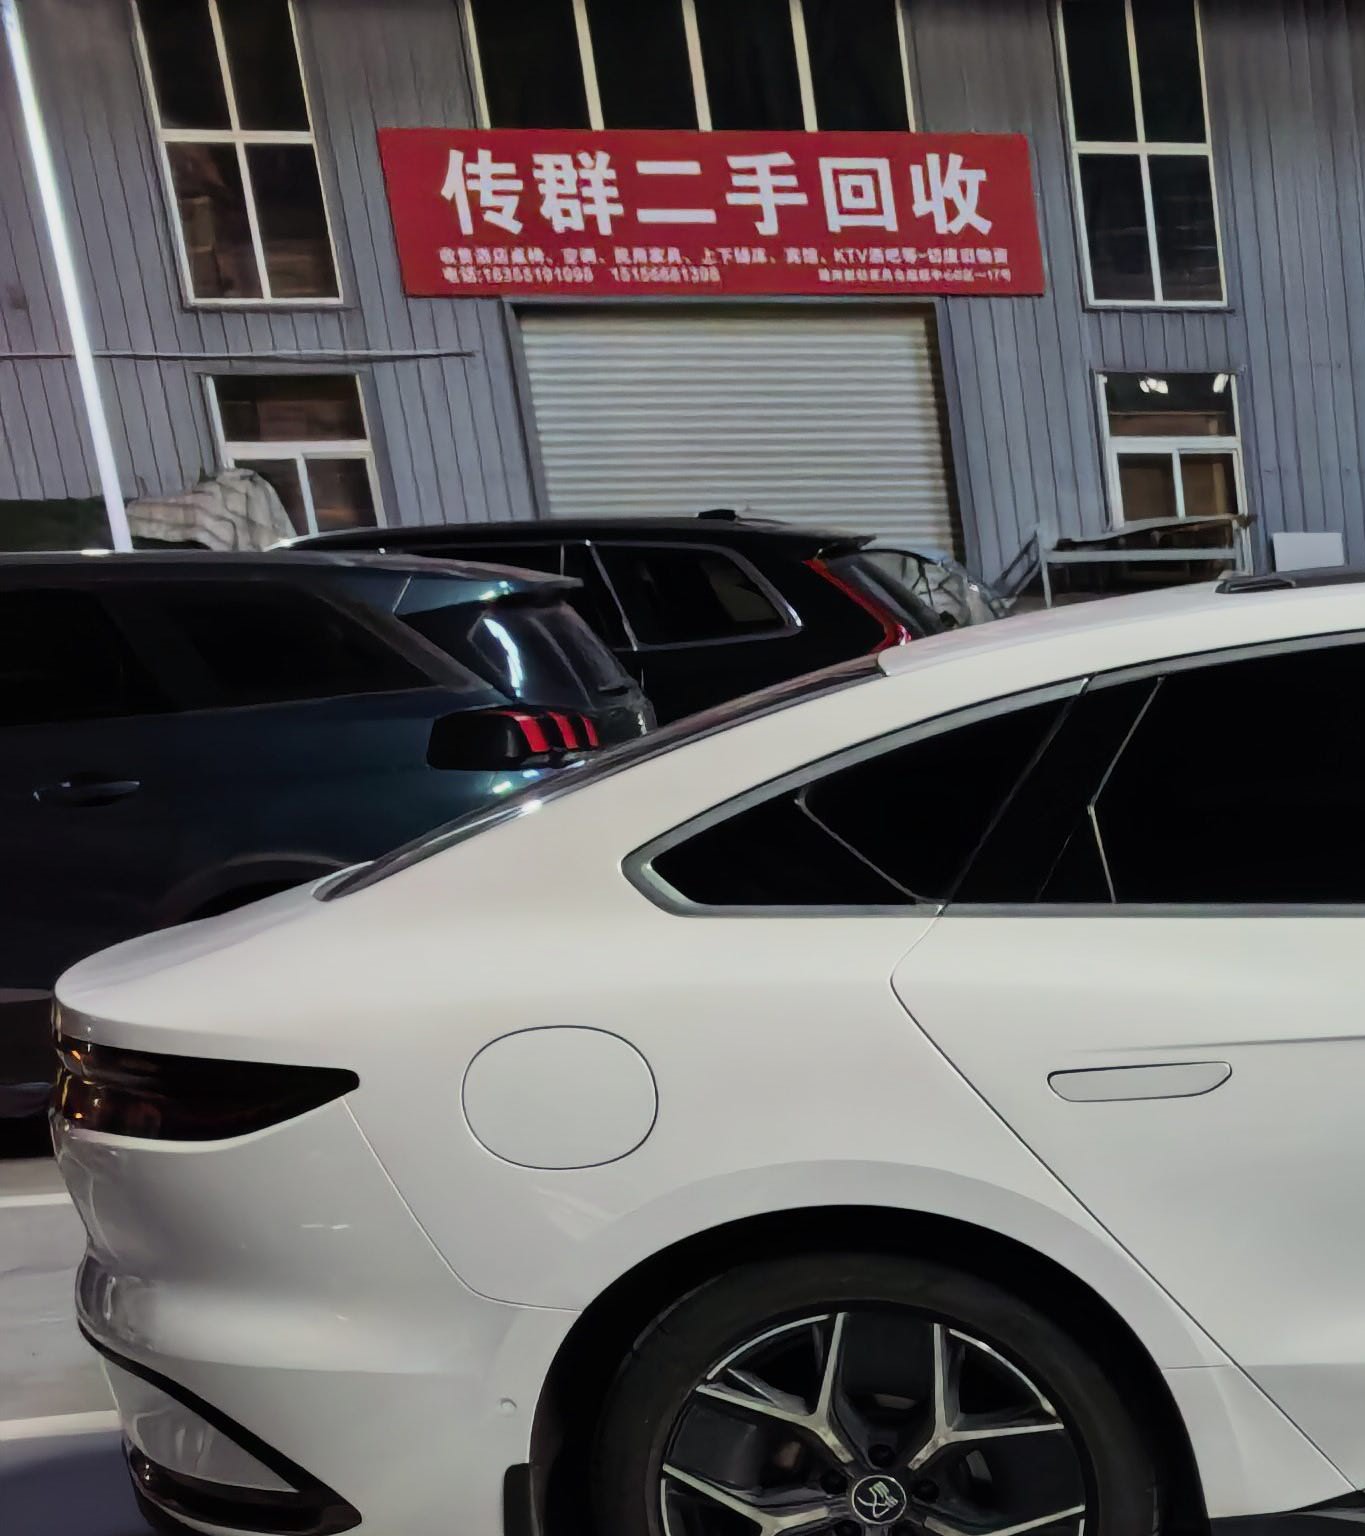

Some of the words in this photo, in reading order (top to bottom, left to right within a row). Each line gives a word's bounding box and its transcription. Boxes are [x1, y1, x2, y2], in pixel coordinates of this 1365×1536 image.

[440, 148, 994, 237] 传群二手回收
